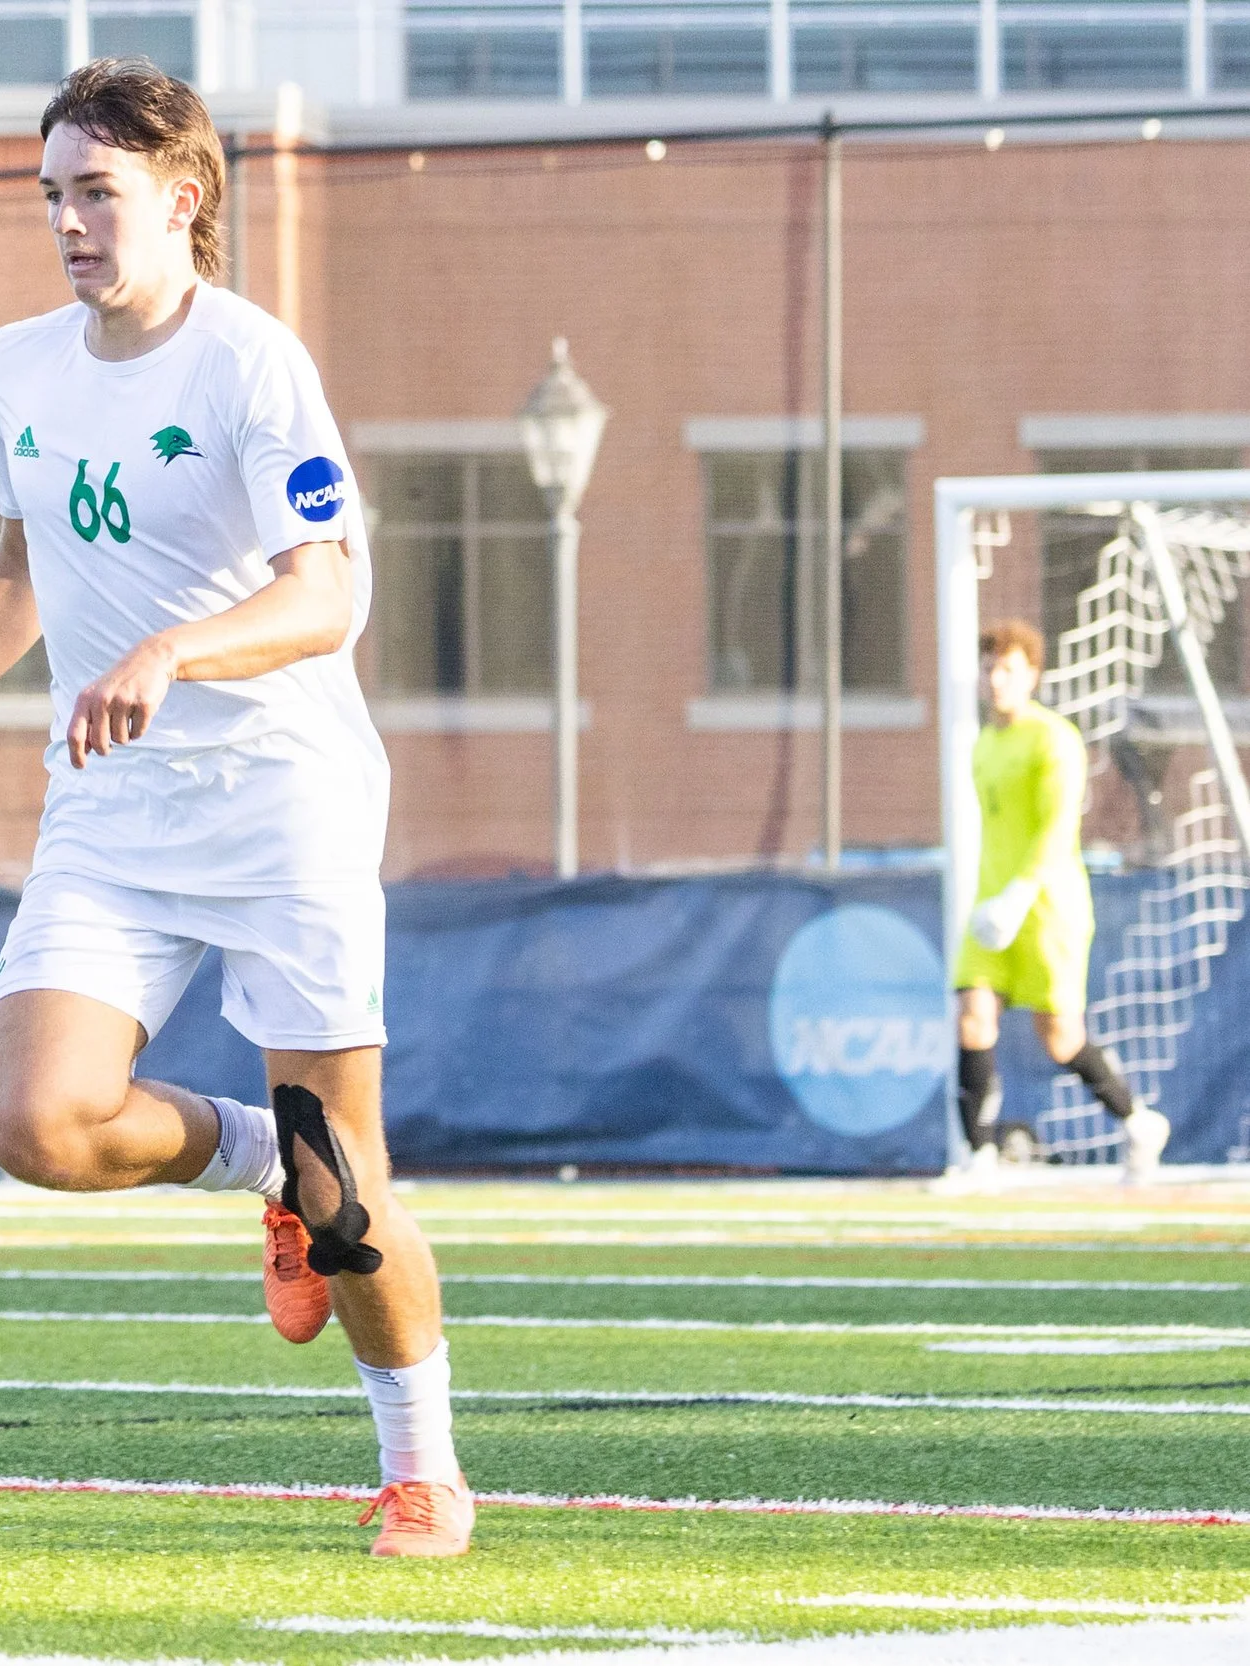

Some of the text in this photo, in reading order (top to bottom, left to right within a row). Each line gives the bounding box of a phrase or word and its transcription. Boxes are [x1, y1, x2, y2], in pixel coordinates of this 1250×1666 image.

[14, 447, 40, 458] adidas
[69, 458, 131, 543] 66
[295, 481, 347, 510] NCAA
[784, 1017, 951, 1077] NCAA
